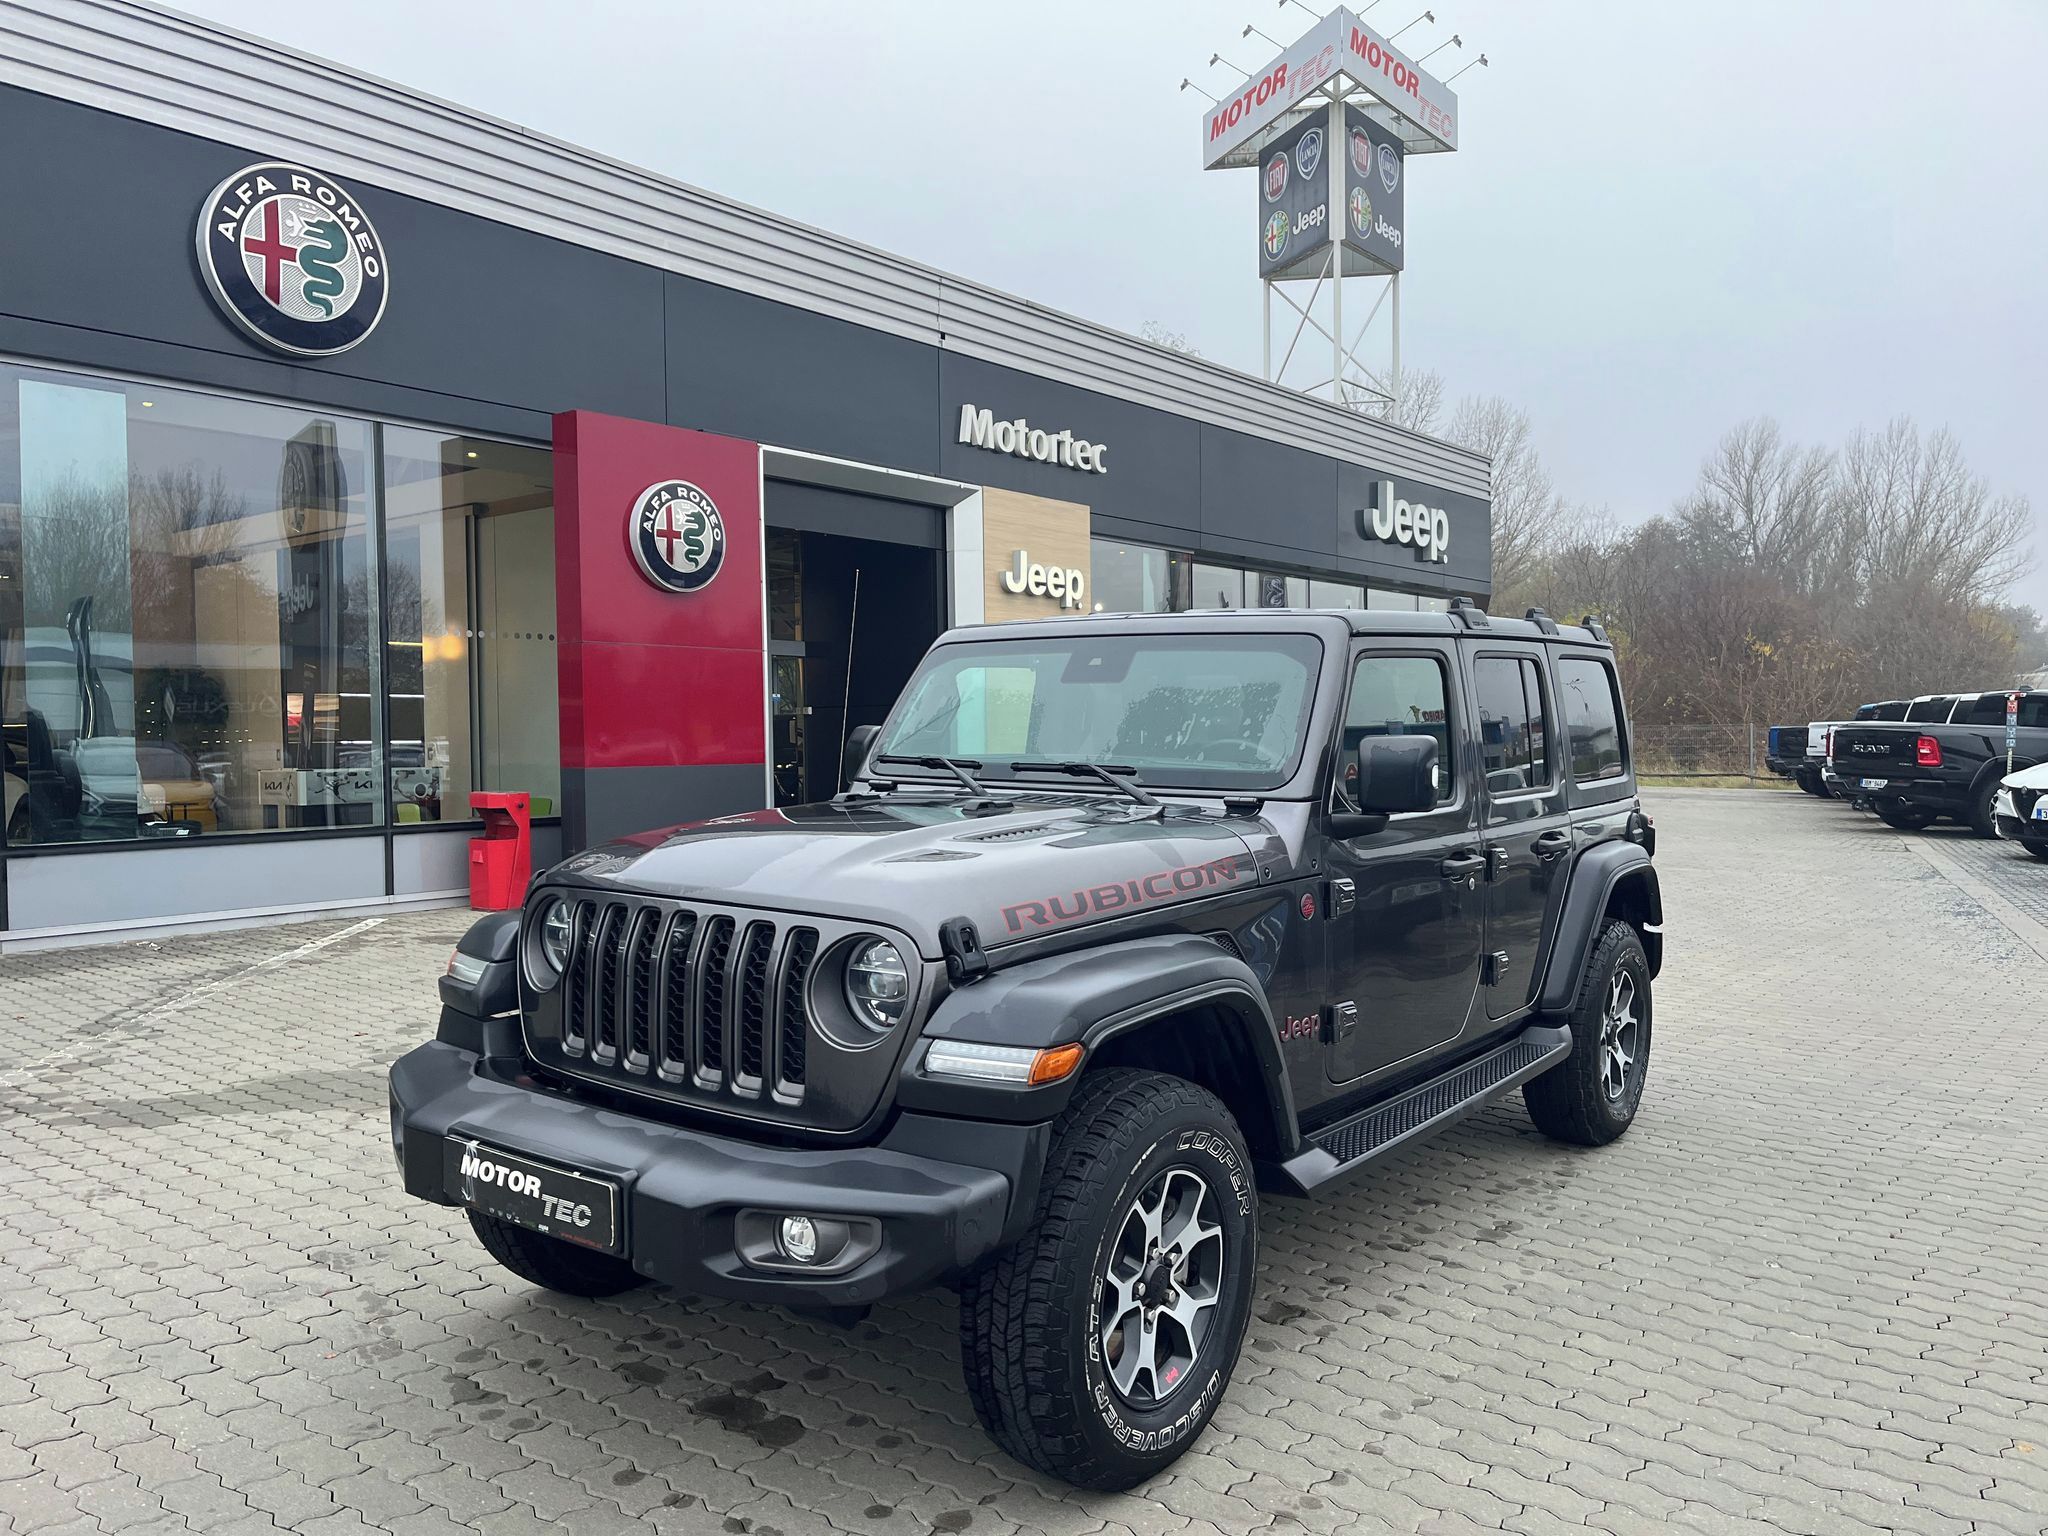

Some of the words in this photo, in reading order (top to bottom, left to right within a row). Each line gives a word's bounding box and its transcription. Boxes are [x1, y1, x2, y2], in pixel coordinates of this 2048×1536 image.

[1269, 163, 1284, 193] FIAT
[1355, 138, 1368, 167] FIAT
[217, 175, 277, 243] ALFA
[290, 174, 379, 278] ROMEO
[1374, 214, 1401, 248] Jeep
[959, 403, 1108, 474] Motortec
[643, 490, 672, 533] ALFA
[677, 486, 721, 542] ROMEO
[1852, 744, 1890, 754] RAM
[1001, 857, 1240, 934] RUBICON
[1280, 1014, 1320, 1042] Jeep
[1176, 1130, 1251, 1217] COOPER
[1095, 1369, 1221, 1452] DISCOVERER
